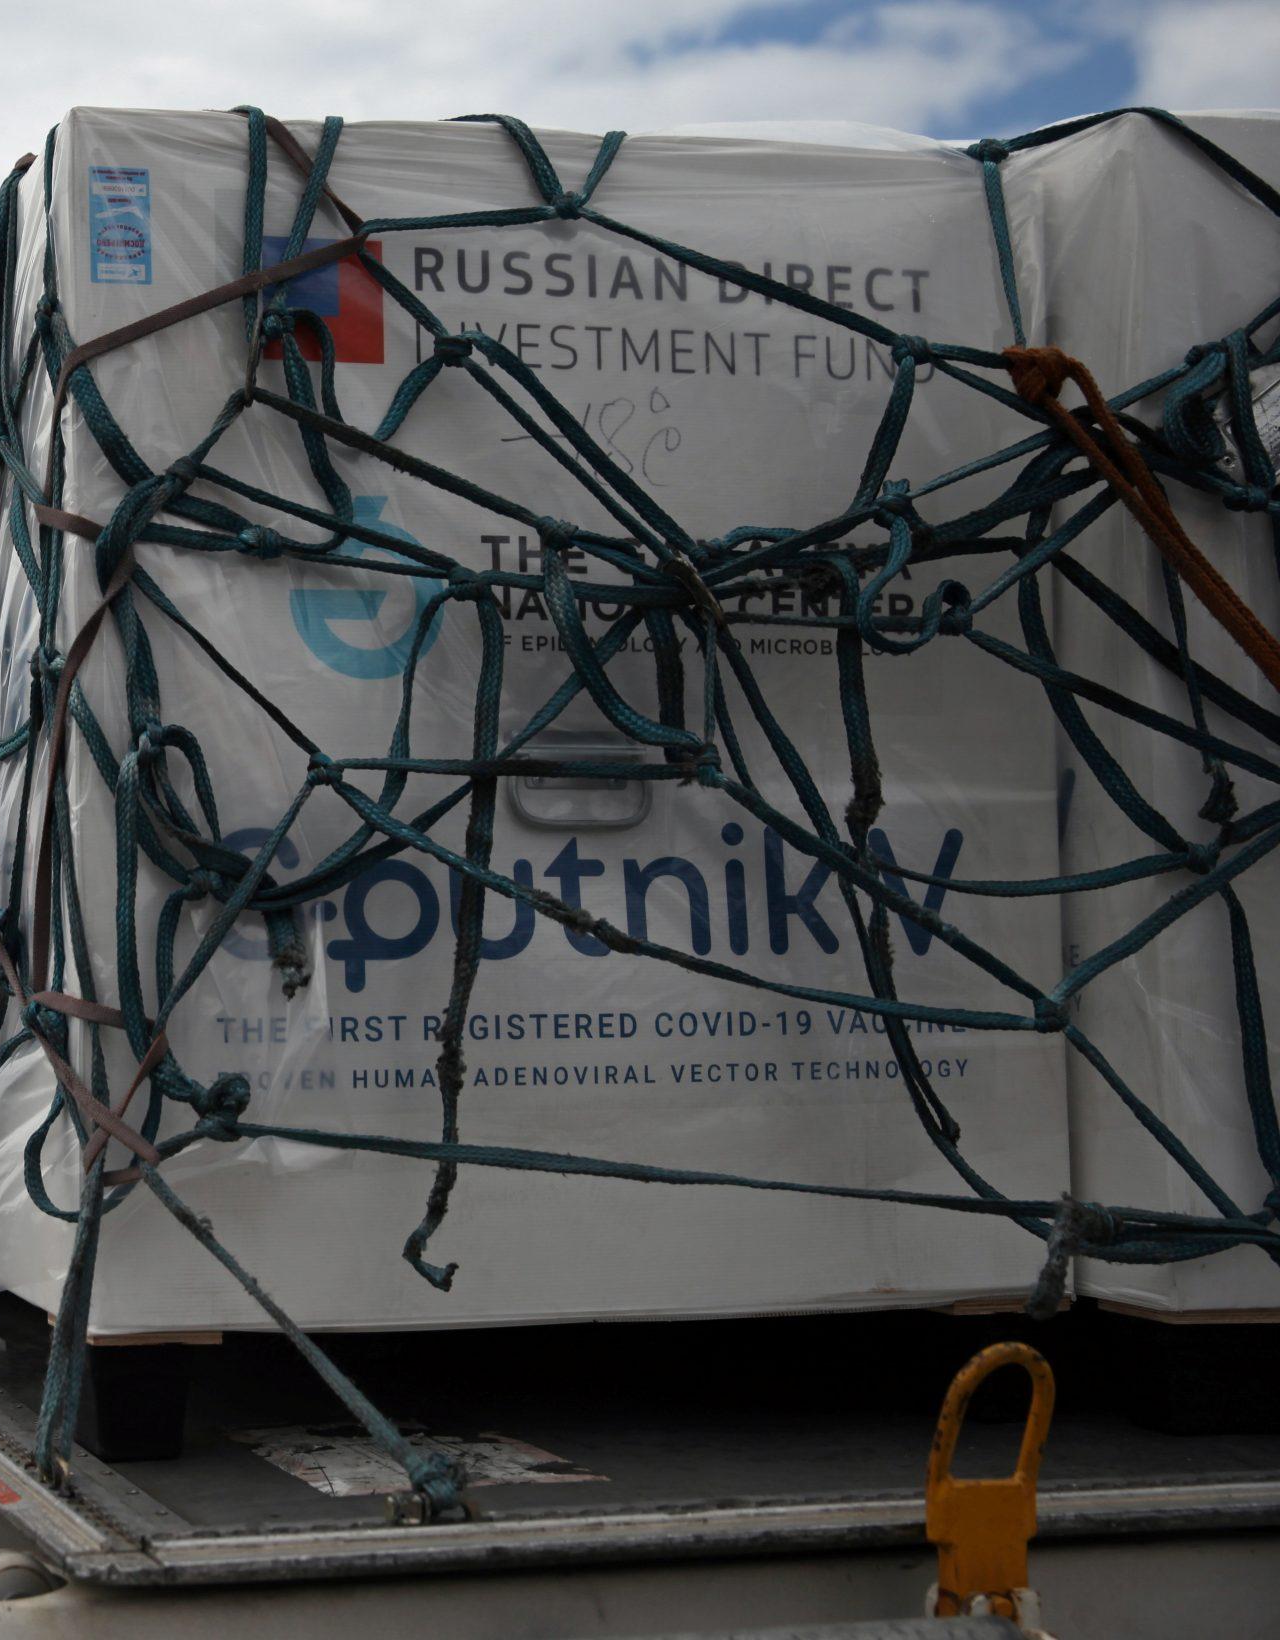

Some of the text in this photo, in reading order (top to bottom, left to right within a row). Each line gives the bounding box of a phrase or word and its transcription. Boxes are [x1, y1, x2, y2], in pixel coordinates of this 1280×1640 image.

[414, 247, 687, 301] RUSSIAN
[415, 320, 935, 384] IVESTMENT FUN
[868, 828, 963, 957] V
[216, 1017, 288, 1043] THE
[424, 1012, 637, 1041] RGISTERED
[655, 1010, 811, 1038] COVID-19
[352, 1067, 437, 1090] HUMA
[474, 1064, 655, 1087] ADENOVIRAL
[671, 1062, 778, 1083] VECTOR
[792, 1059, 968, 1081] TECHNOOGY
